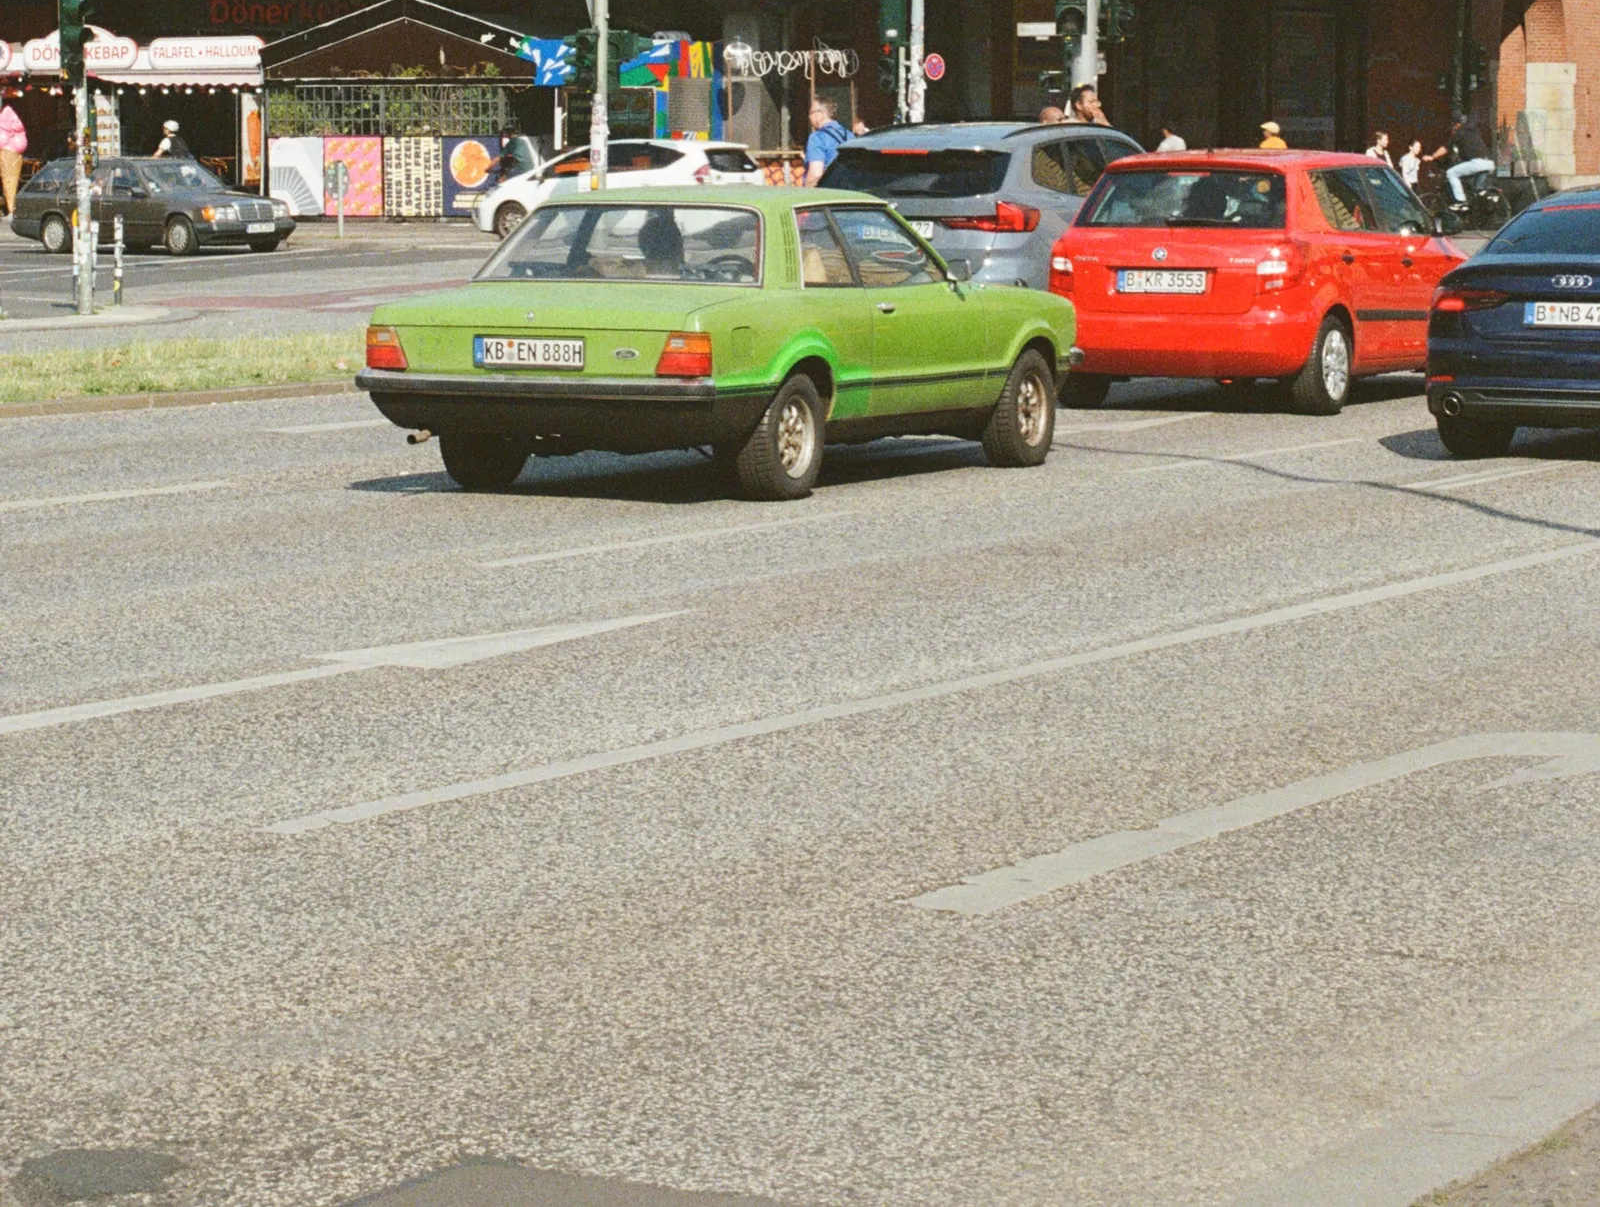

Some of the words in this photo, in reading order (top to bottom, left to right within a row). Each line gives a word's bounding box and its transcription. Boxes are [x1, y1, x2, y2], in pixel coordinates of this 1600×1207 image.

[84, 46, 129, 60] KEBAP
[153, 46, 195, 59] FALAFEL
[404, 137, 412, 206] SCHNITZEL
[385, 147, 393, 216] SCHNITZEL
[1126, 272, 1135, 287] B
[1145, 272, 1163, 287] KR
[1168, 272, 1203, 288] 3553
[1536, 305, 1546, 322] B
[1559, 306, 1581, 322] NB
[485, 341, 504, 360] KB
[517, 342, 537, 361] EN
[542, 343, 582, 363] 888H
